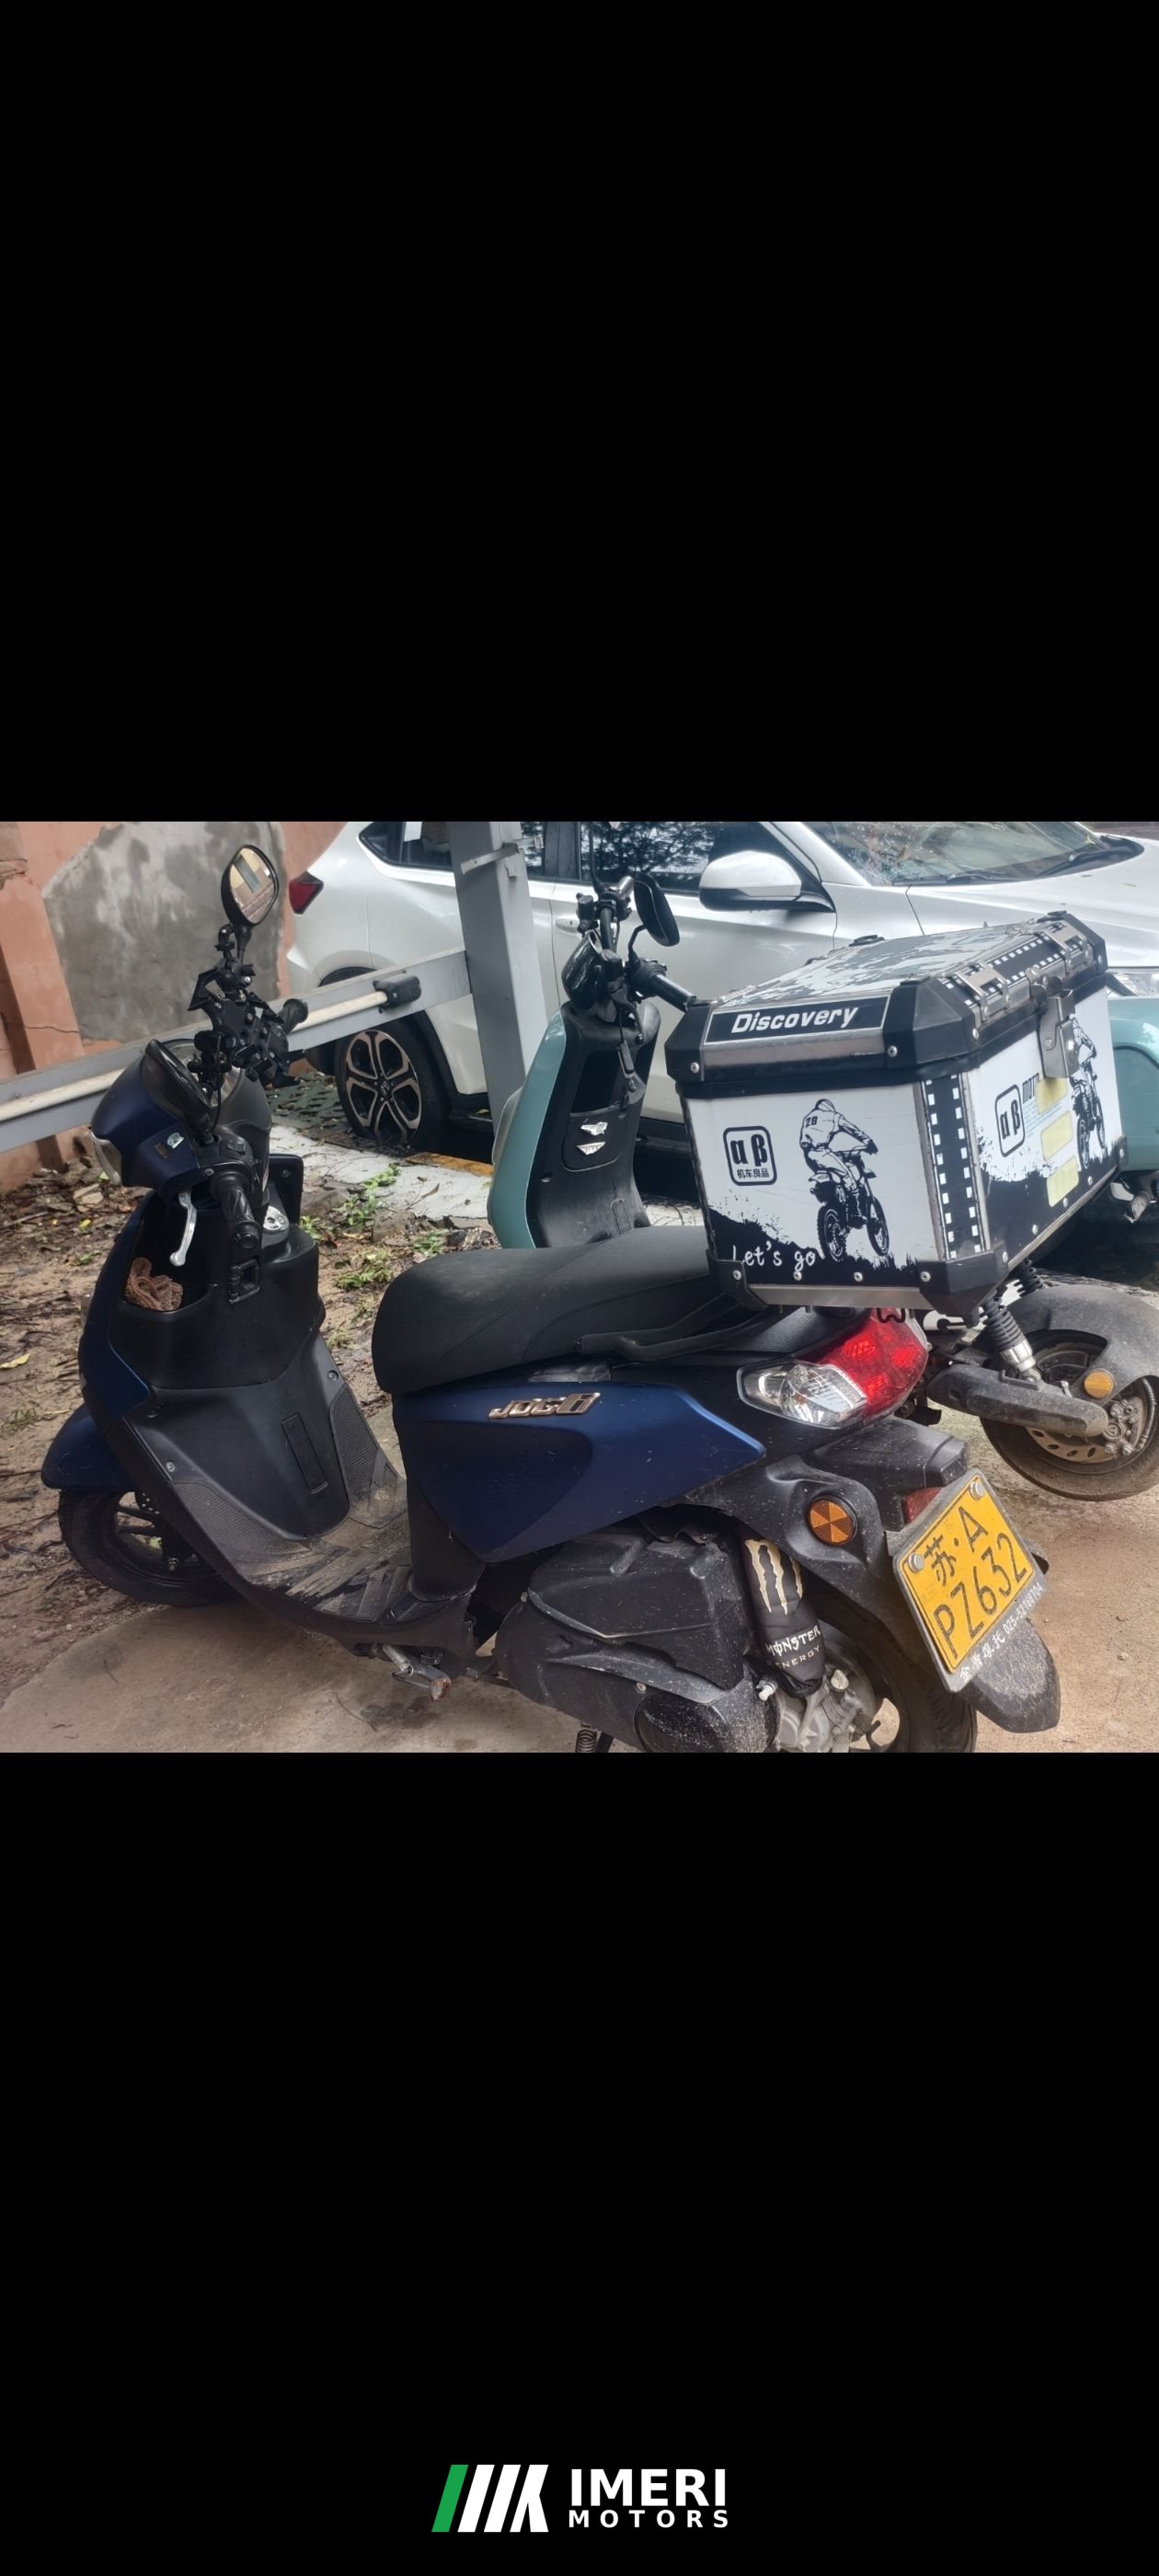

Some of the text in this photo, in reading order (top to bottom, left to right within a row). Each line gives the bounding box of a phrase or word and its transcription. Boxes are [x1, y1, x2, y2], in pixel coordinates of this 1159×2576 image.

[731, 1007, 859, 1033] Discovery
[737, 1167, 769, 1179] 机车良品
[794, 1250, 816, 1272] go
[934, 1533, 1027, 1660] PZ632
[765, 1625, 821, 1657] MONSTER
[775, 1645, 820, 1668] NERGY
